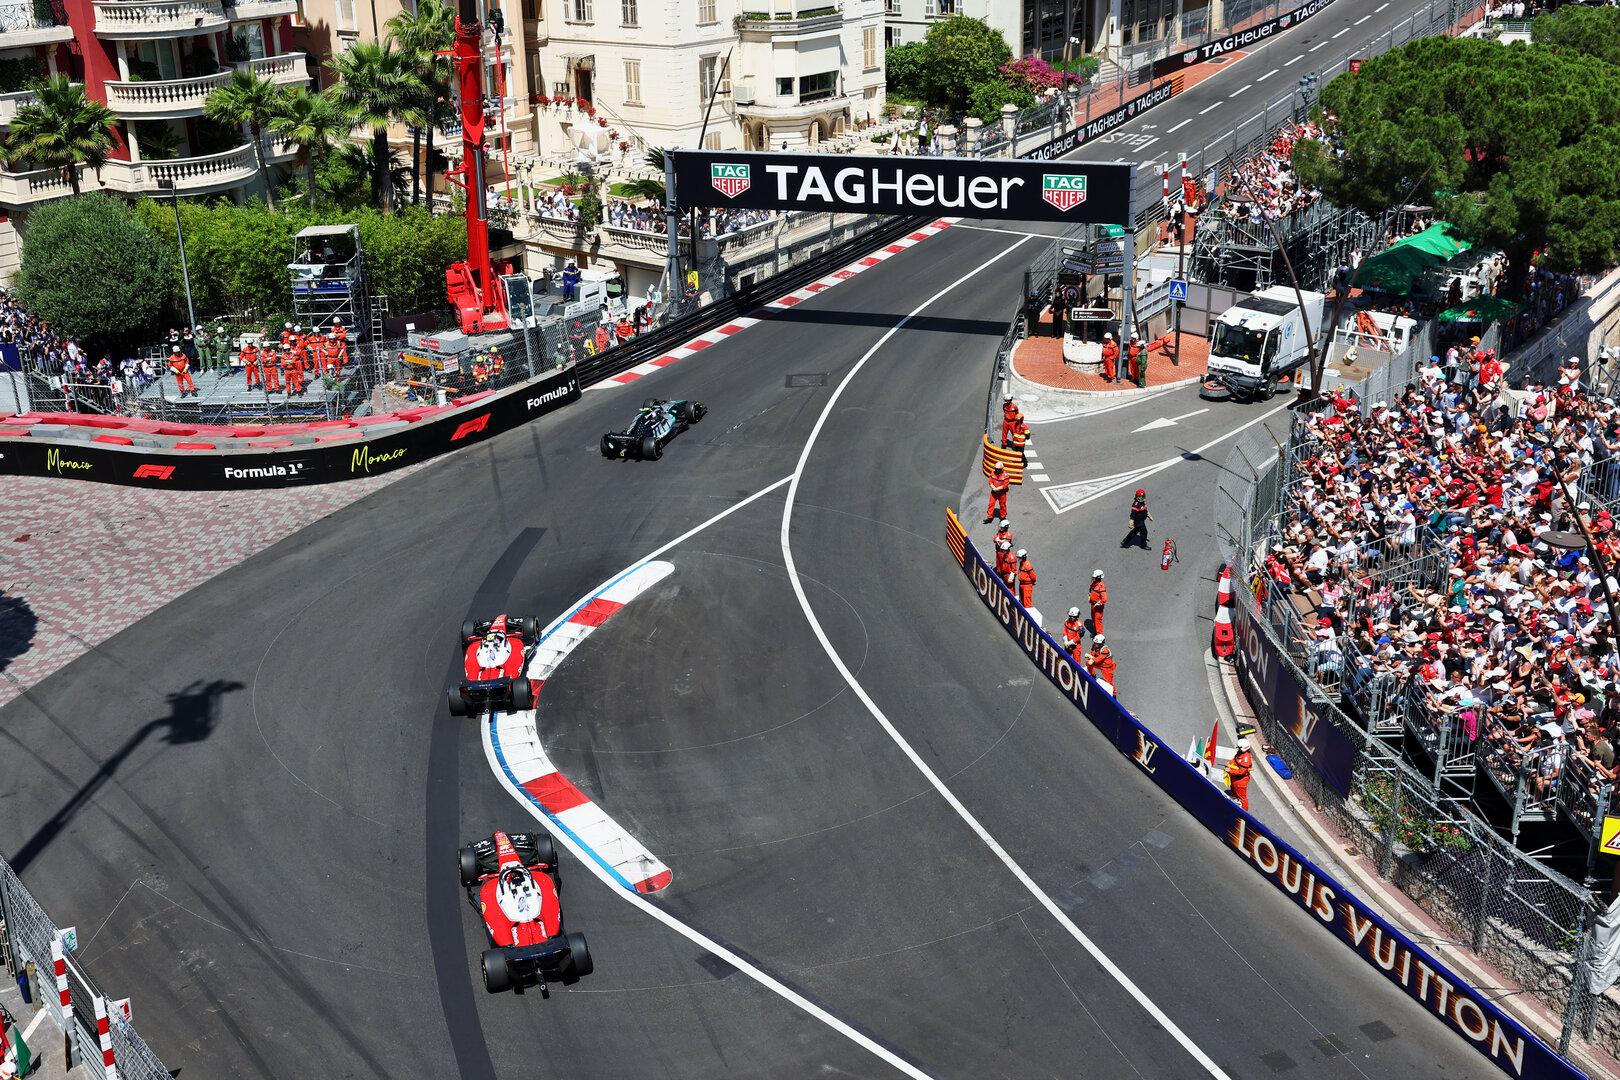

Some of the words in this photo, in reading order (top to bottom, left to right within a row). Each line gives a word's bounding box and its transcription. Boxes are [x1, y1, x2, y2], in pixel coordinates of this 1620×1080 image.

[714, 165, 747, 177] TAG
[713, 178, 749, 197] HEUER
[1046, 176, 1083, 189] TAG
[1044, 190, 1084, 208] HEUER
[527, 386, 568, 410] Formula
[450, 413, 491, 441] F1
[351, 445, 407, 473] Monaco
[132, 464, 176, 480] F1
[224, 465, 286, 479] Formula
[971, 556, 1011, 625] LOUIS
[1014, 607, 1089, 710] VUITTON
[1236, 818, 1336, 923] LOUIS
[1346, 904, 1525, 1077] VUITTON
